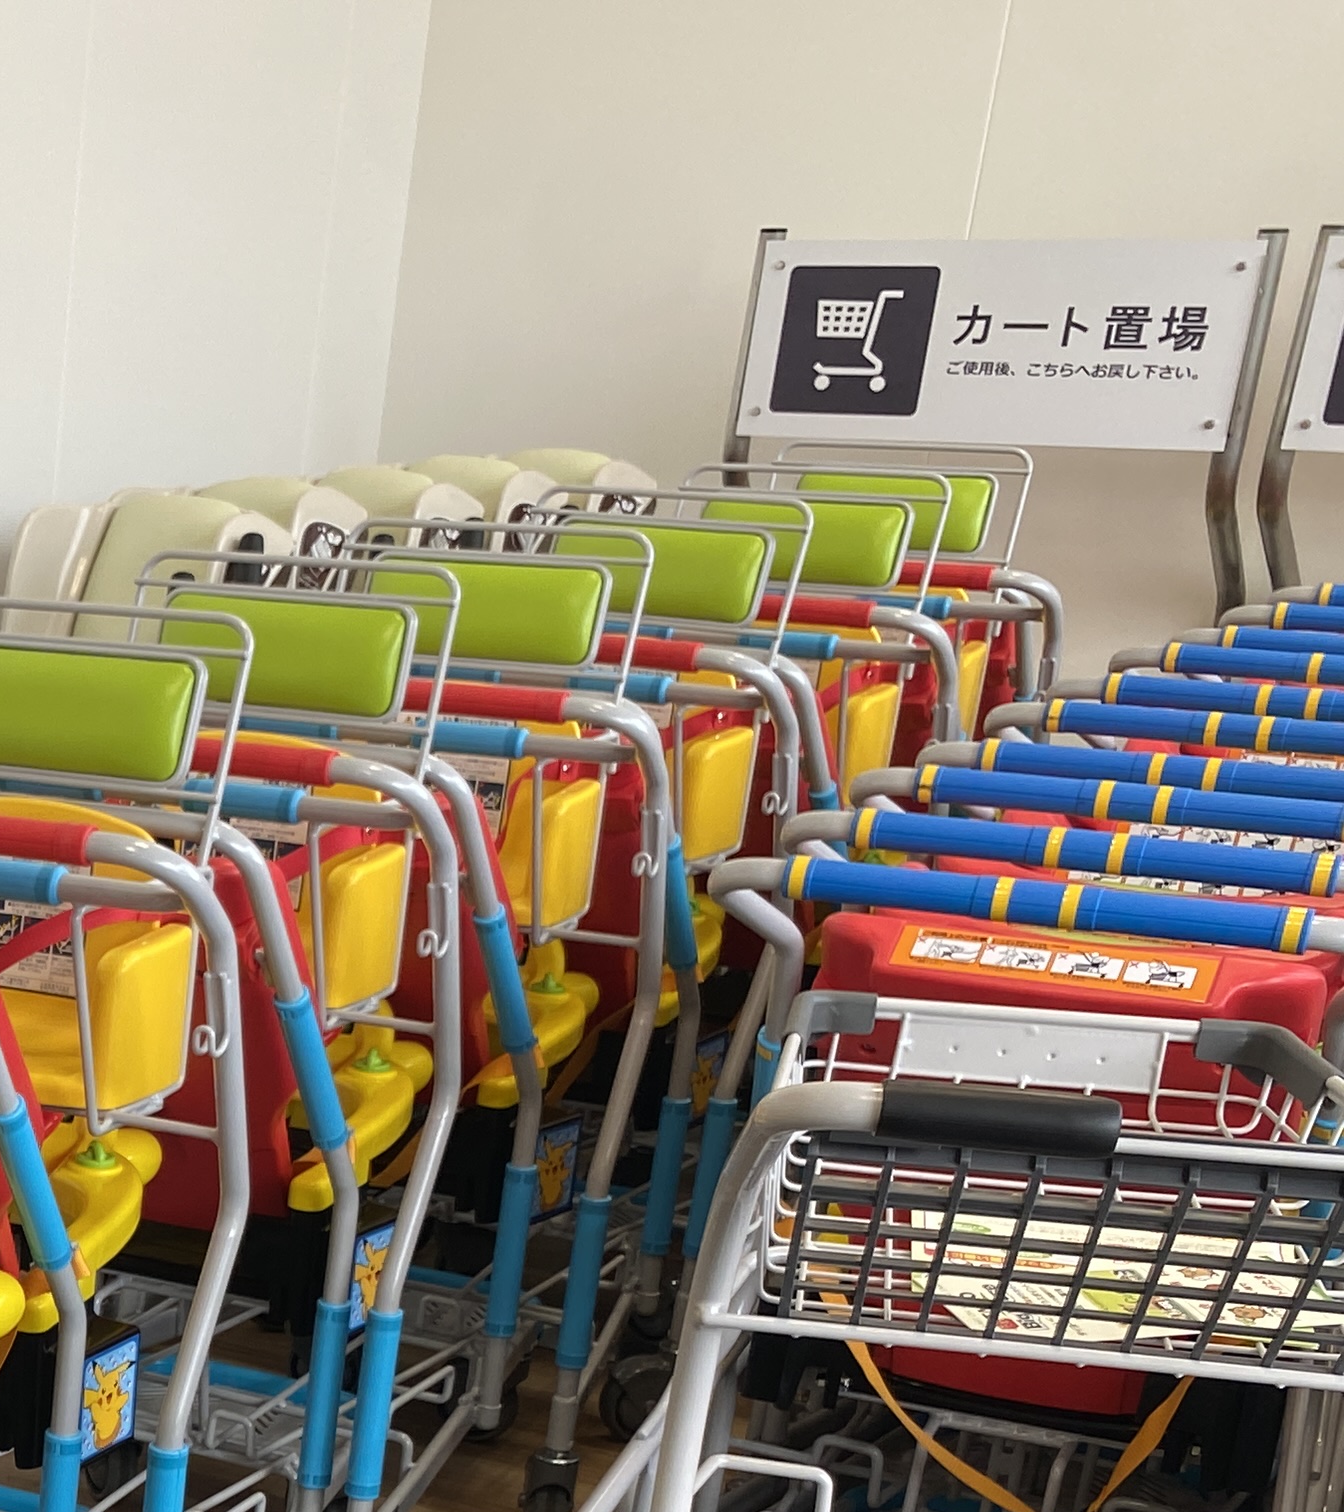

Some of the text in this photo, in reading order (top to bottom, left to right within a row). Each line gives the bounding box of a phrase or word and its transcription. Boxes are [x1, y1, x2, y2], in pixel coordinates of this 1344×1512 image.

[952, 304, 1210, 352] カート置場
